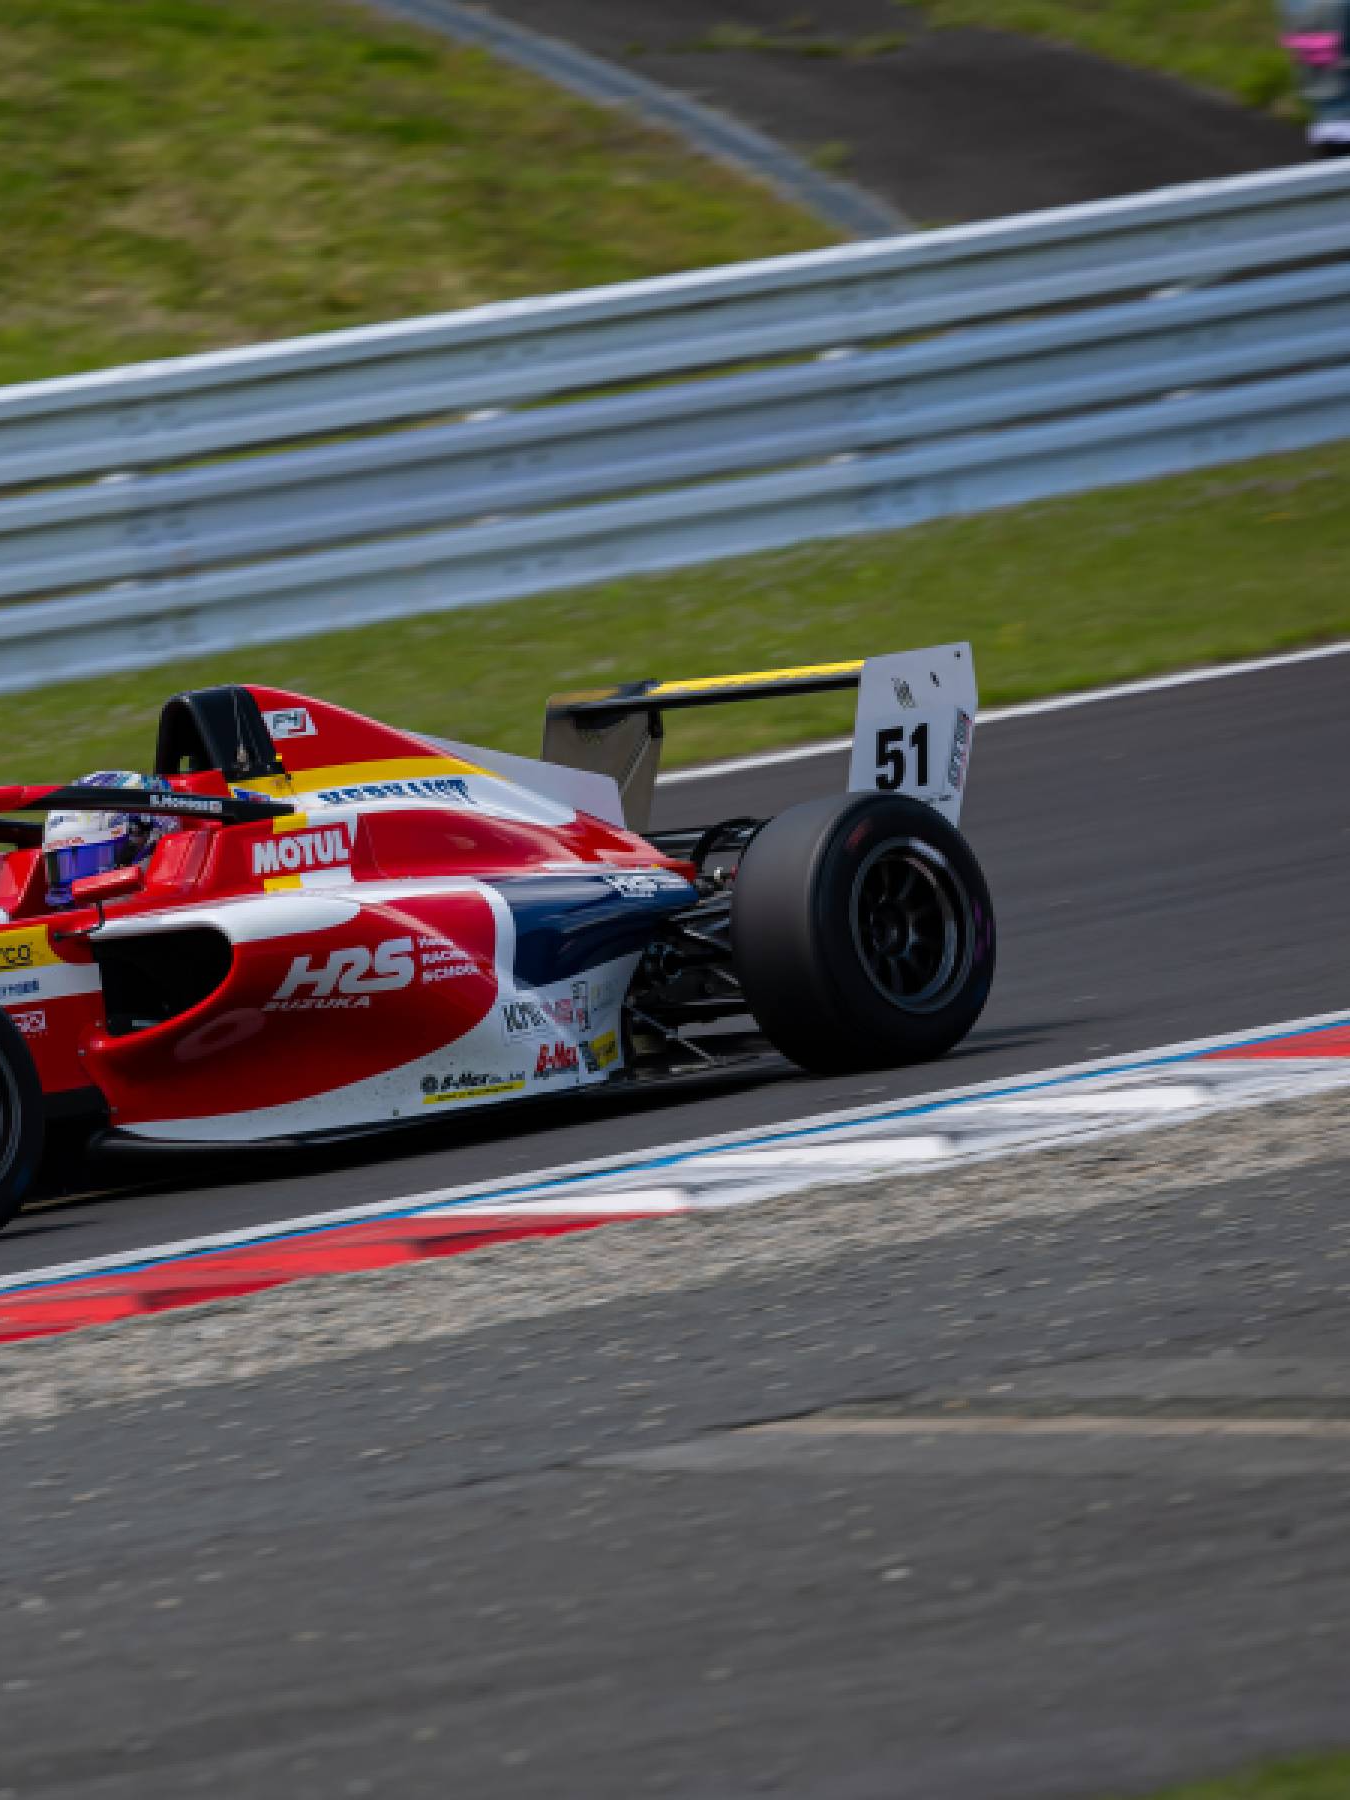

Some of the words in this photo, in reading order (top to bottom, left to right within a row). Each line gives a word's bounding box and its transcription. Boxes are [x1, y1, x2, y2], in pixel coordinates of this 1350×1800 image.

[876, 723, 929, 790] 51
[253, 829, 349, 876] MOTUL
[272, 936, 415, 1000] HRS
[262, 996, 371, 1012] SUZUKA
